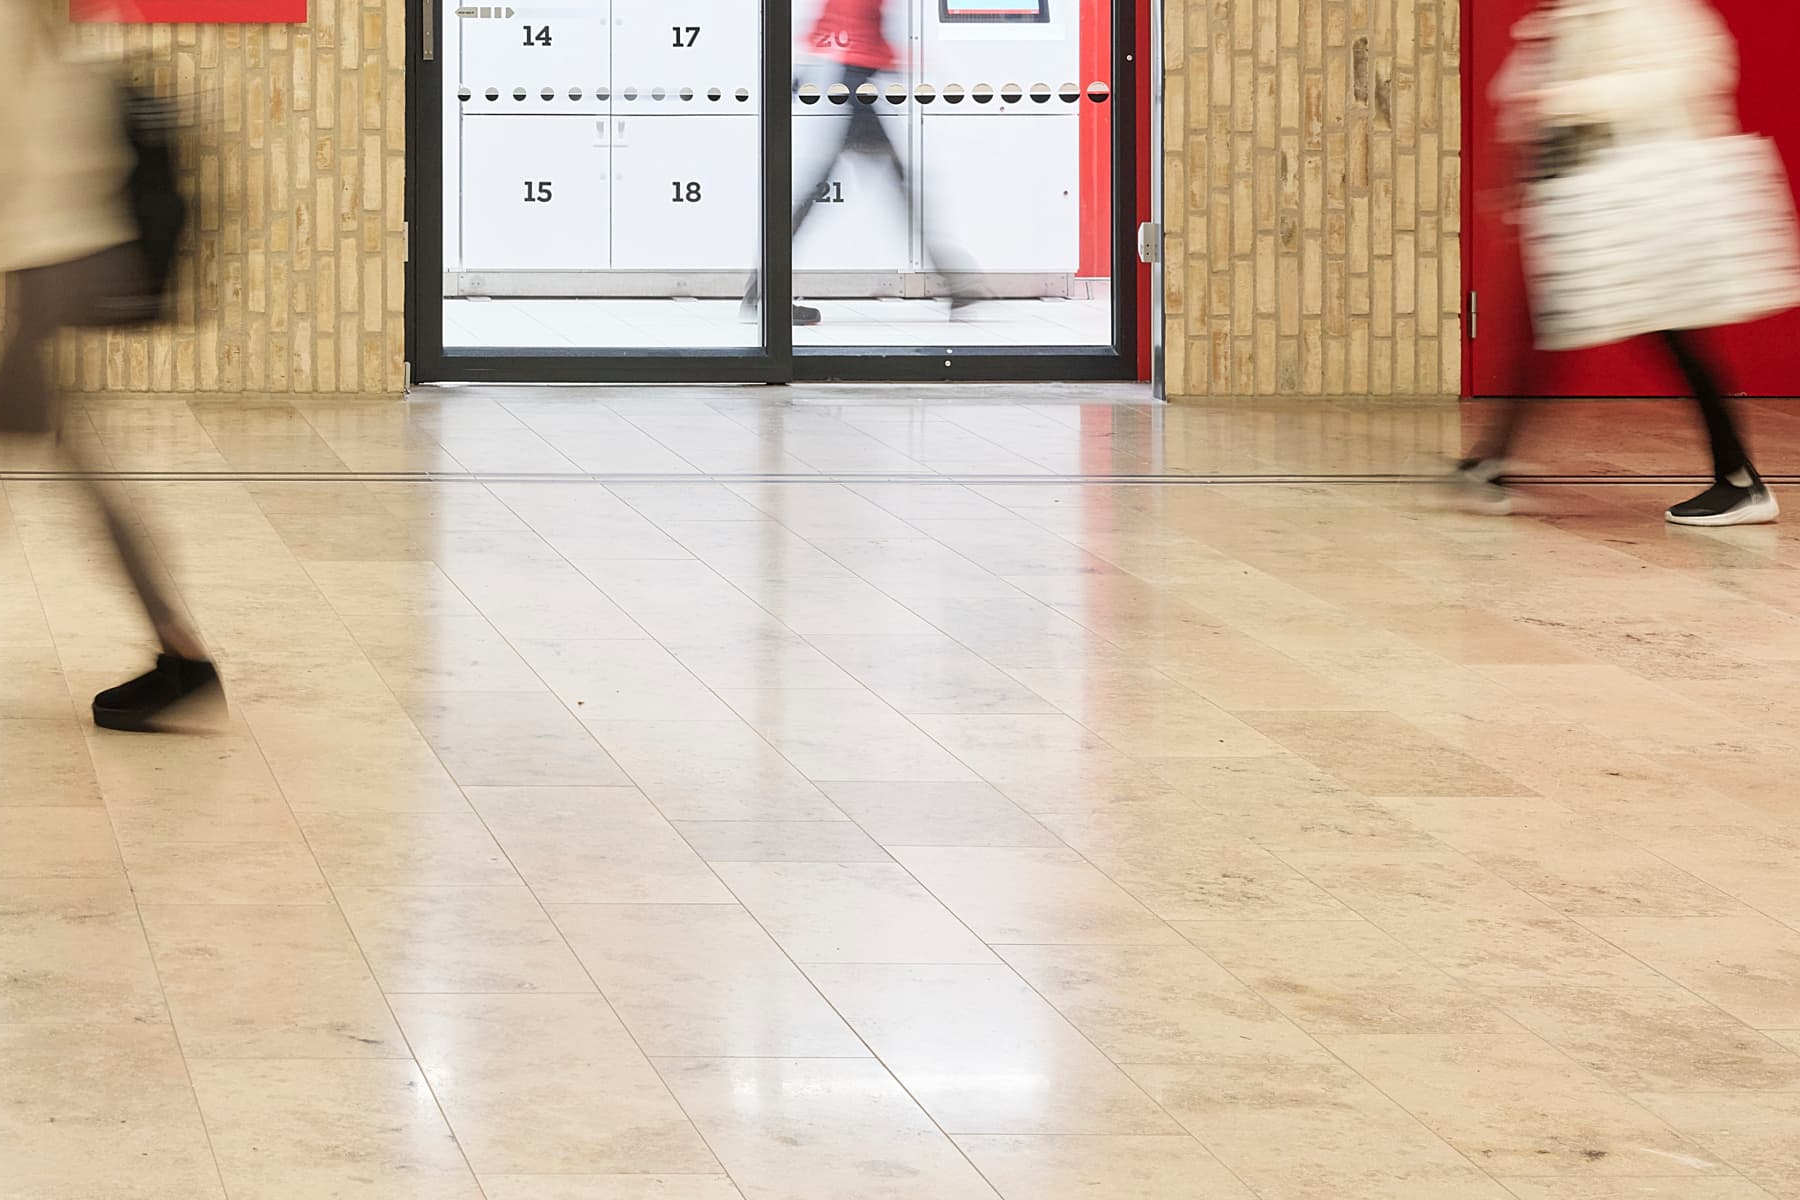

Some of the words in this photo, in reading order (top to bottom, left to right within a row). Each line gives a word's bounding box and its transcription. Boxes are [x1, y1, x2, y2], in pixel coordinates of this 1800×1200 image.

[522, 26, 553, 47] 14
[672, 27, 701, 47] 17
[524, 182, 552, 202] 15
[672, 182, 702, 203] 18
[816, 181, 844, 202] 21
